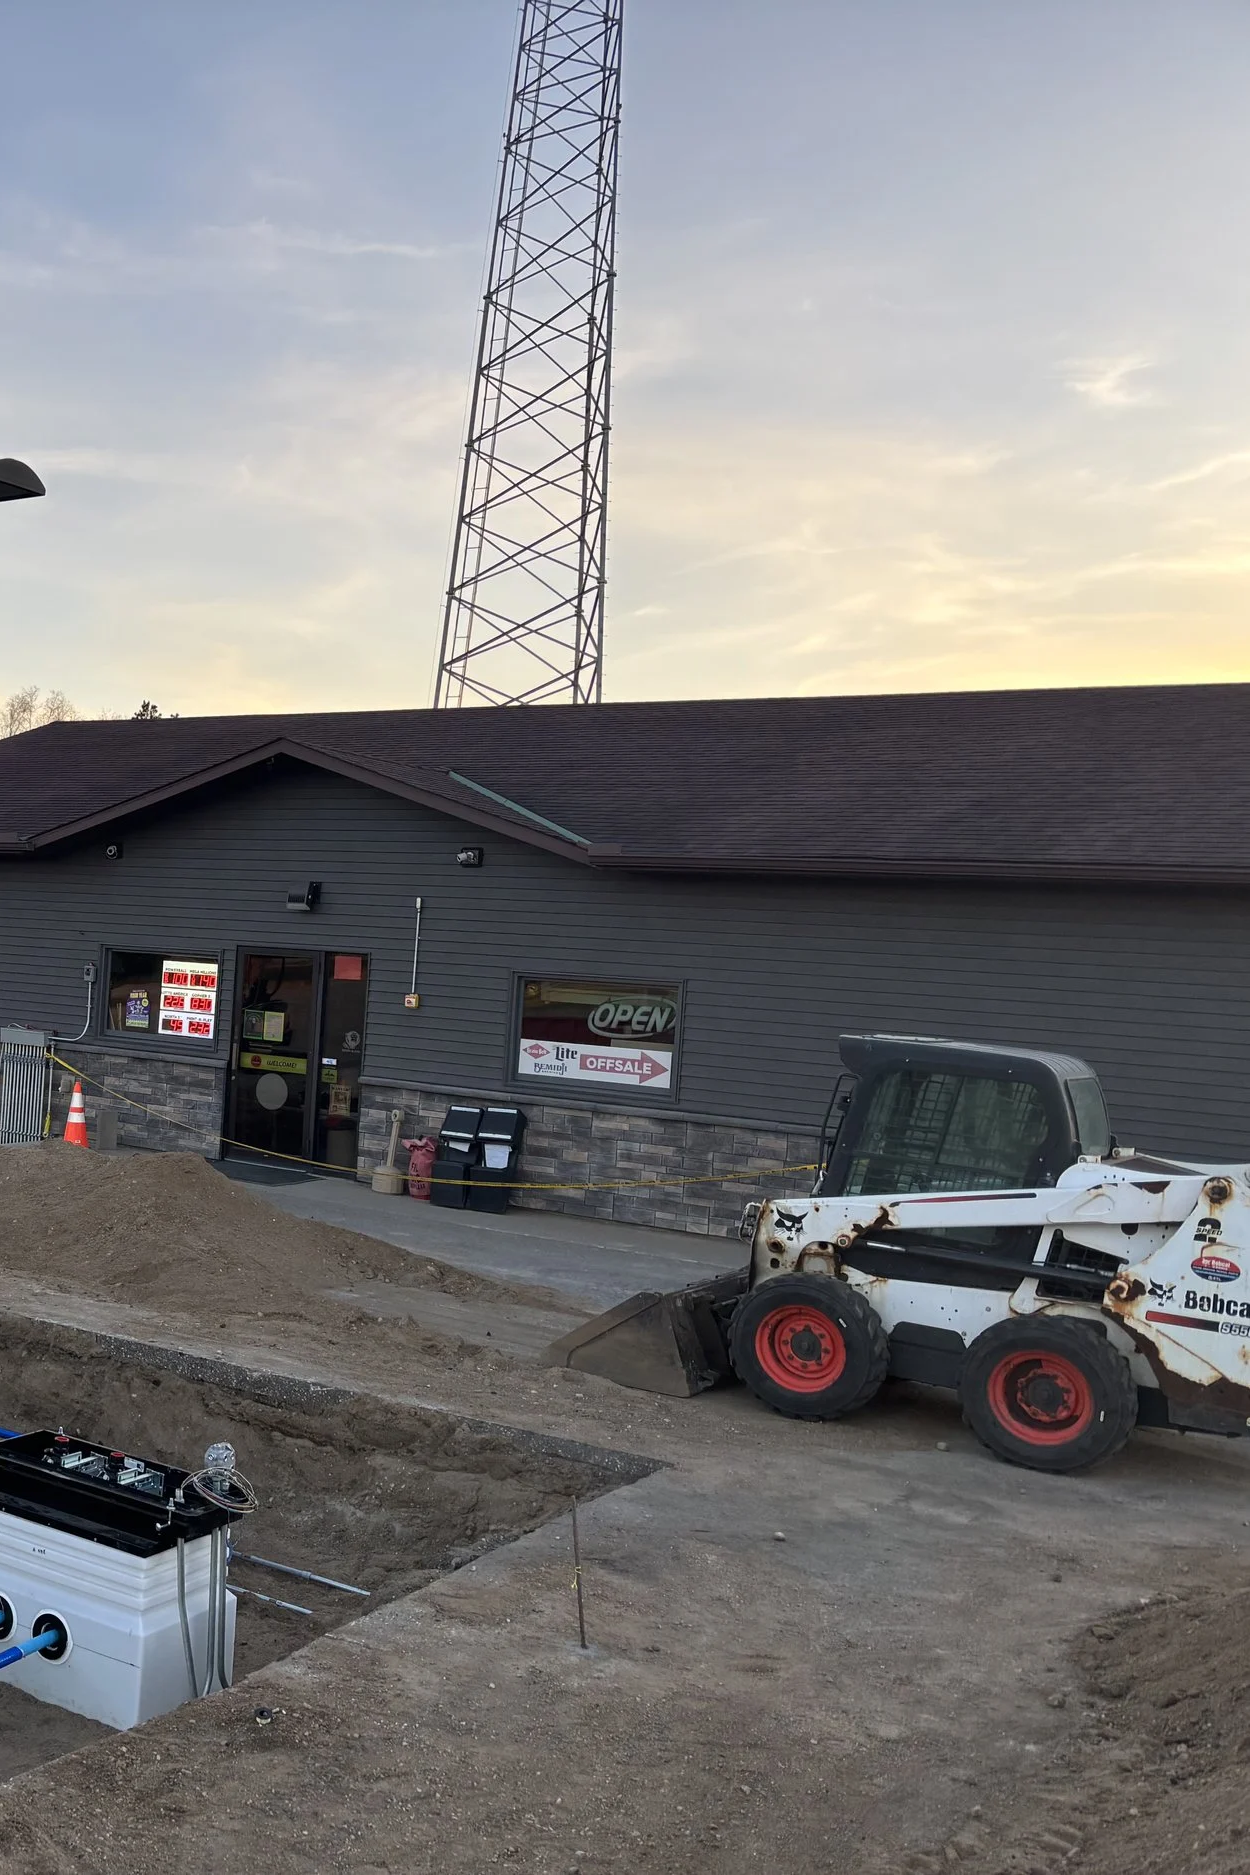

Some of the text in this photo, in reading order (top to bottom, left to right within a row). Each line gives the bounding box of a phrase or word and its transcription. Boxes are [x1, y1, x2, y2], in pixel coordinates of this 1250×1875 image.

[594, 1003, 672, 1032] OPEN
[555, 1046, 578, 1061] Lite
[534, 1062, 568, 1075] BEMIDJI
[586, 1057, 652, 1075] OFFSALE
[1196, 1227, 1223, 1236] SPEED
[1220, 1322, 1250, 1338] S55
